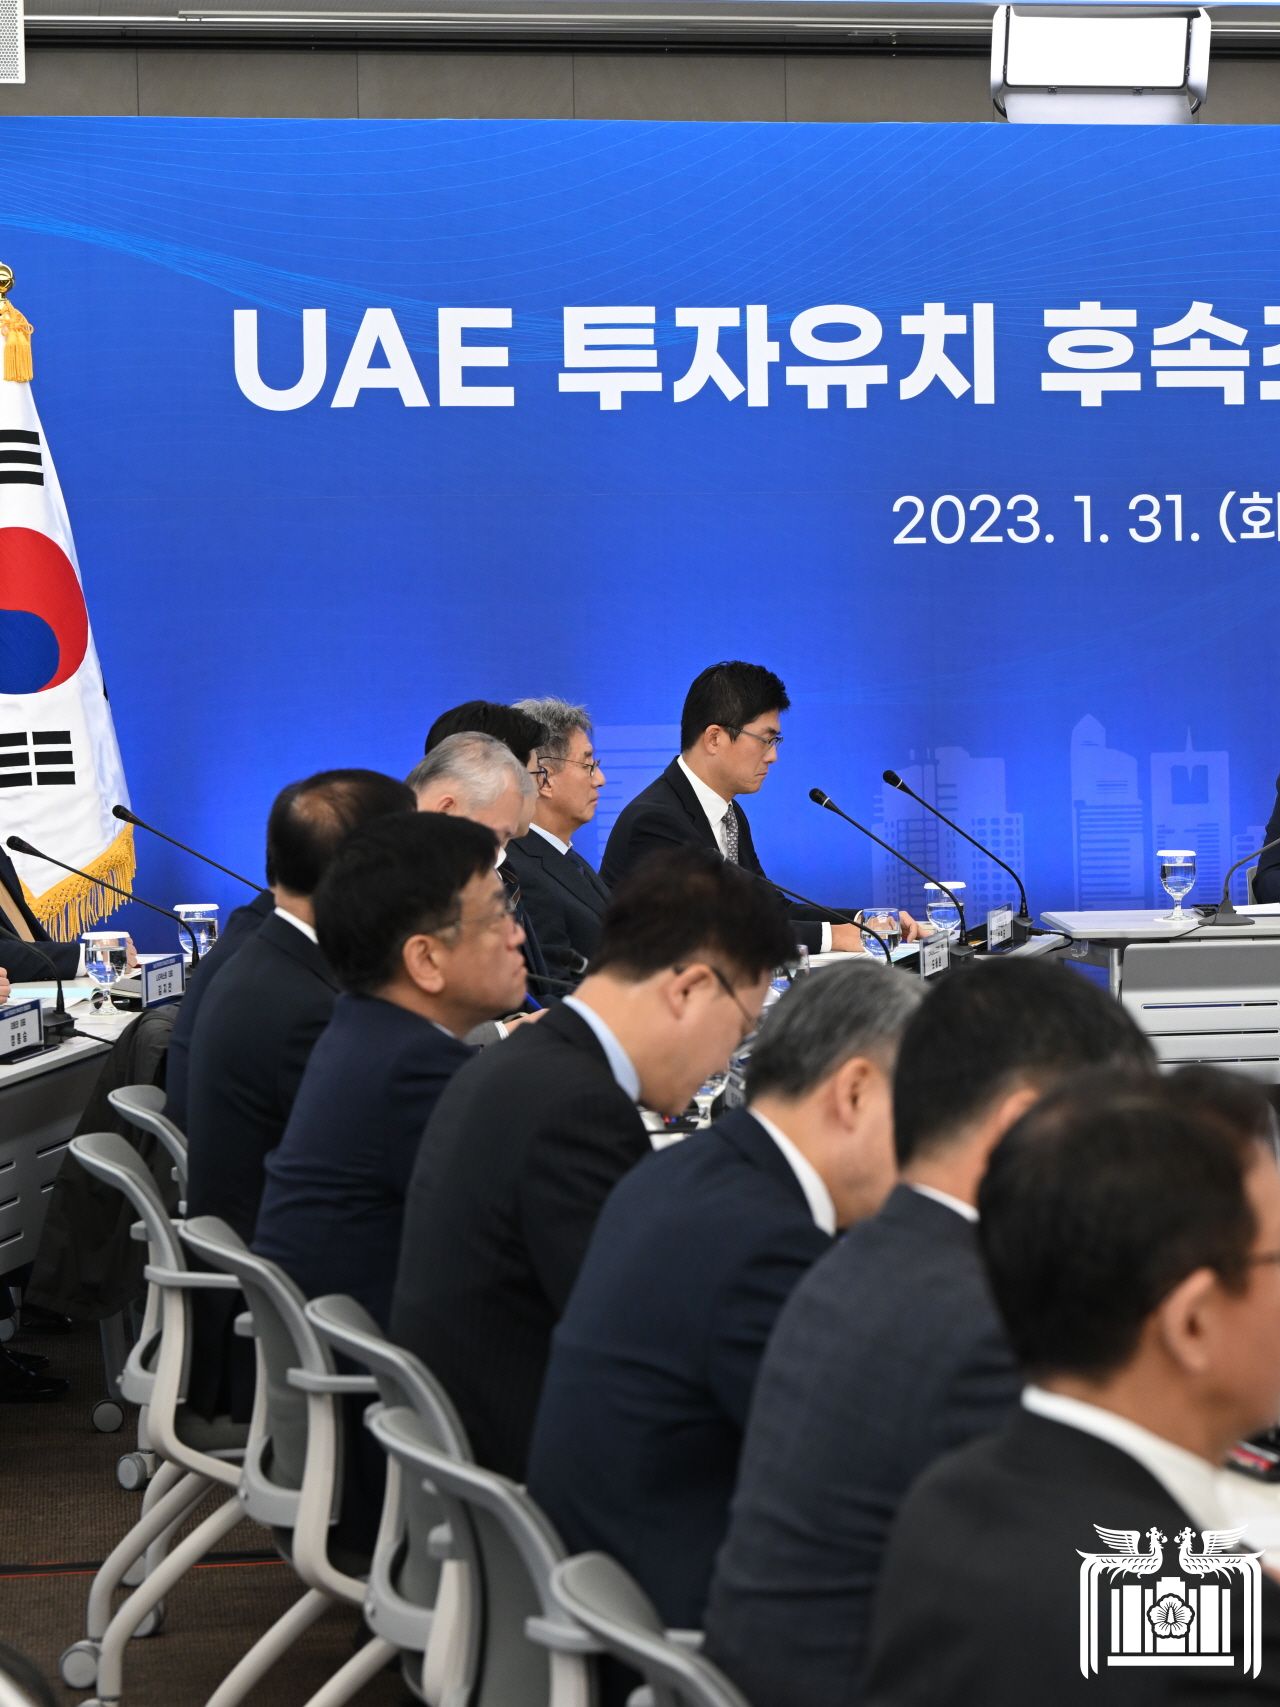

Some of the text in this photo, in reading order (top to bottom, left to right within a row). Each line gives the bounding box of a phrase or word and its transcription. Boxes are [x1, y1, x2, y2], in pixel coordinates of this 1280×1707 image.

[235, 309, 515, 412] UAE
[558, 303, 995, 411] 투자유치
[893, 495, 1055, 545] 2023.
[1075, 496, 1110, 543] 1.
[1129, 494, 1201, 543] 31.
